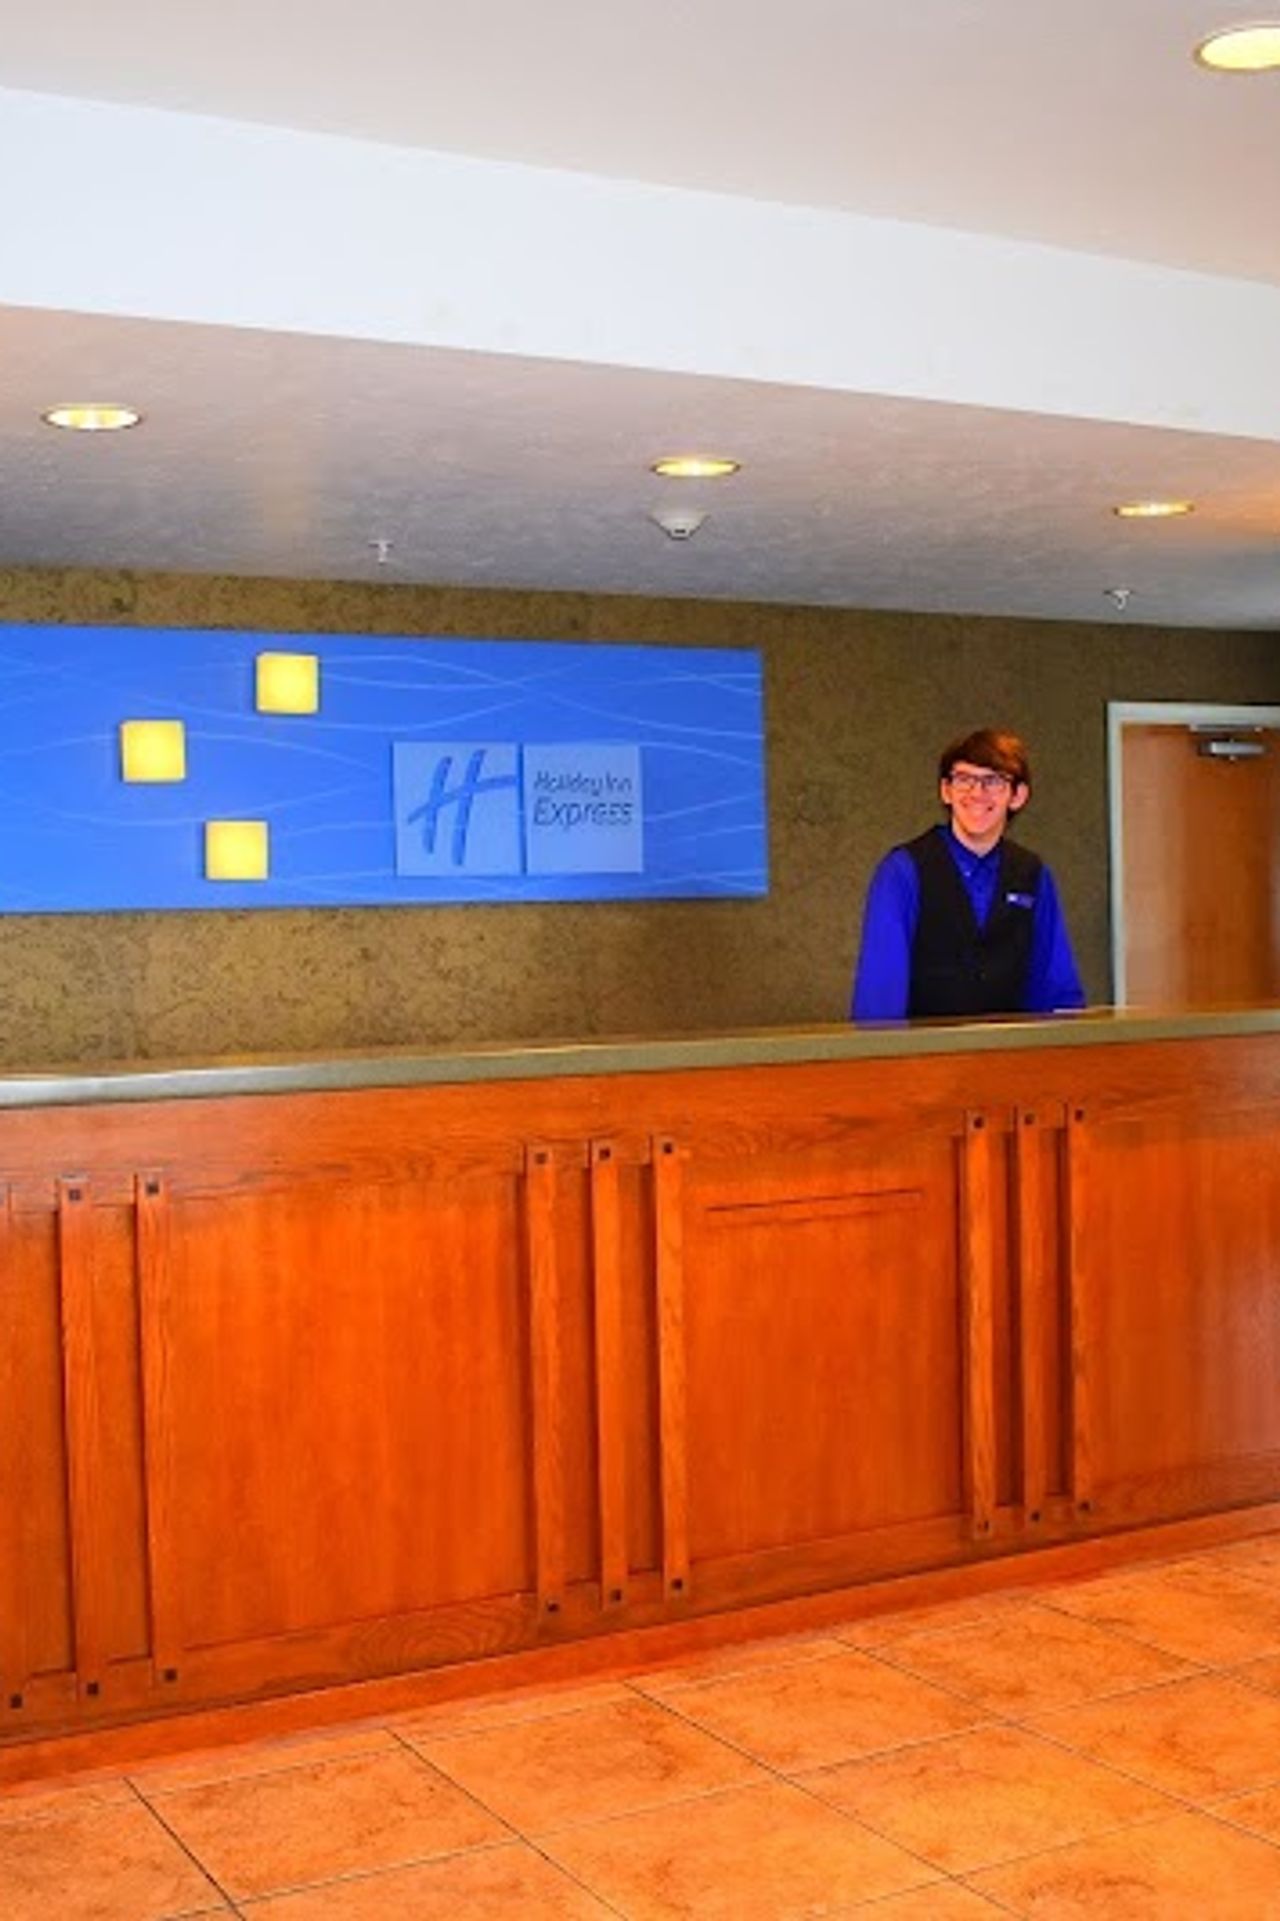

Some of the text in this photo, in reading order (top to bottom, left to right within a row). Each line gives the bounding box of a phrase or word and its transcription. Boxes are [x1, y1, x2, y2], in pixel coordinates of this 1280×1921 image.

[533, 770, 632, 796] Holiday Inn
[533, 797, 633, 829] Express
